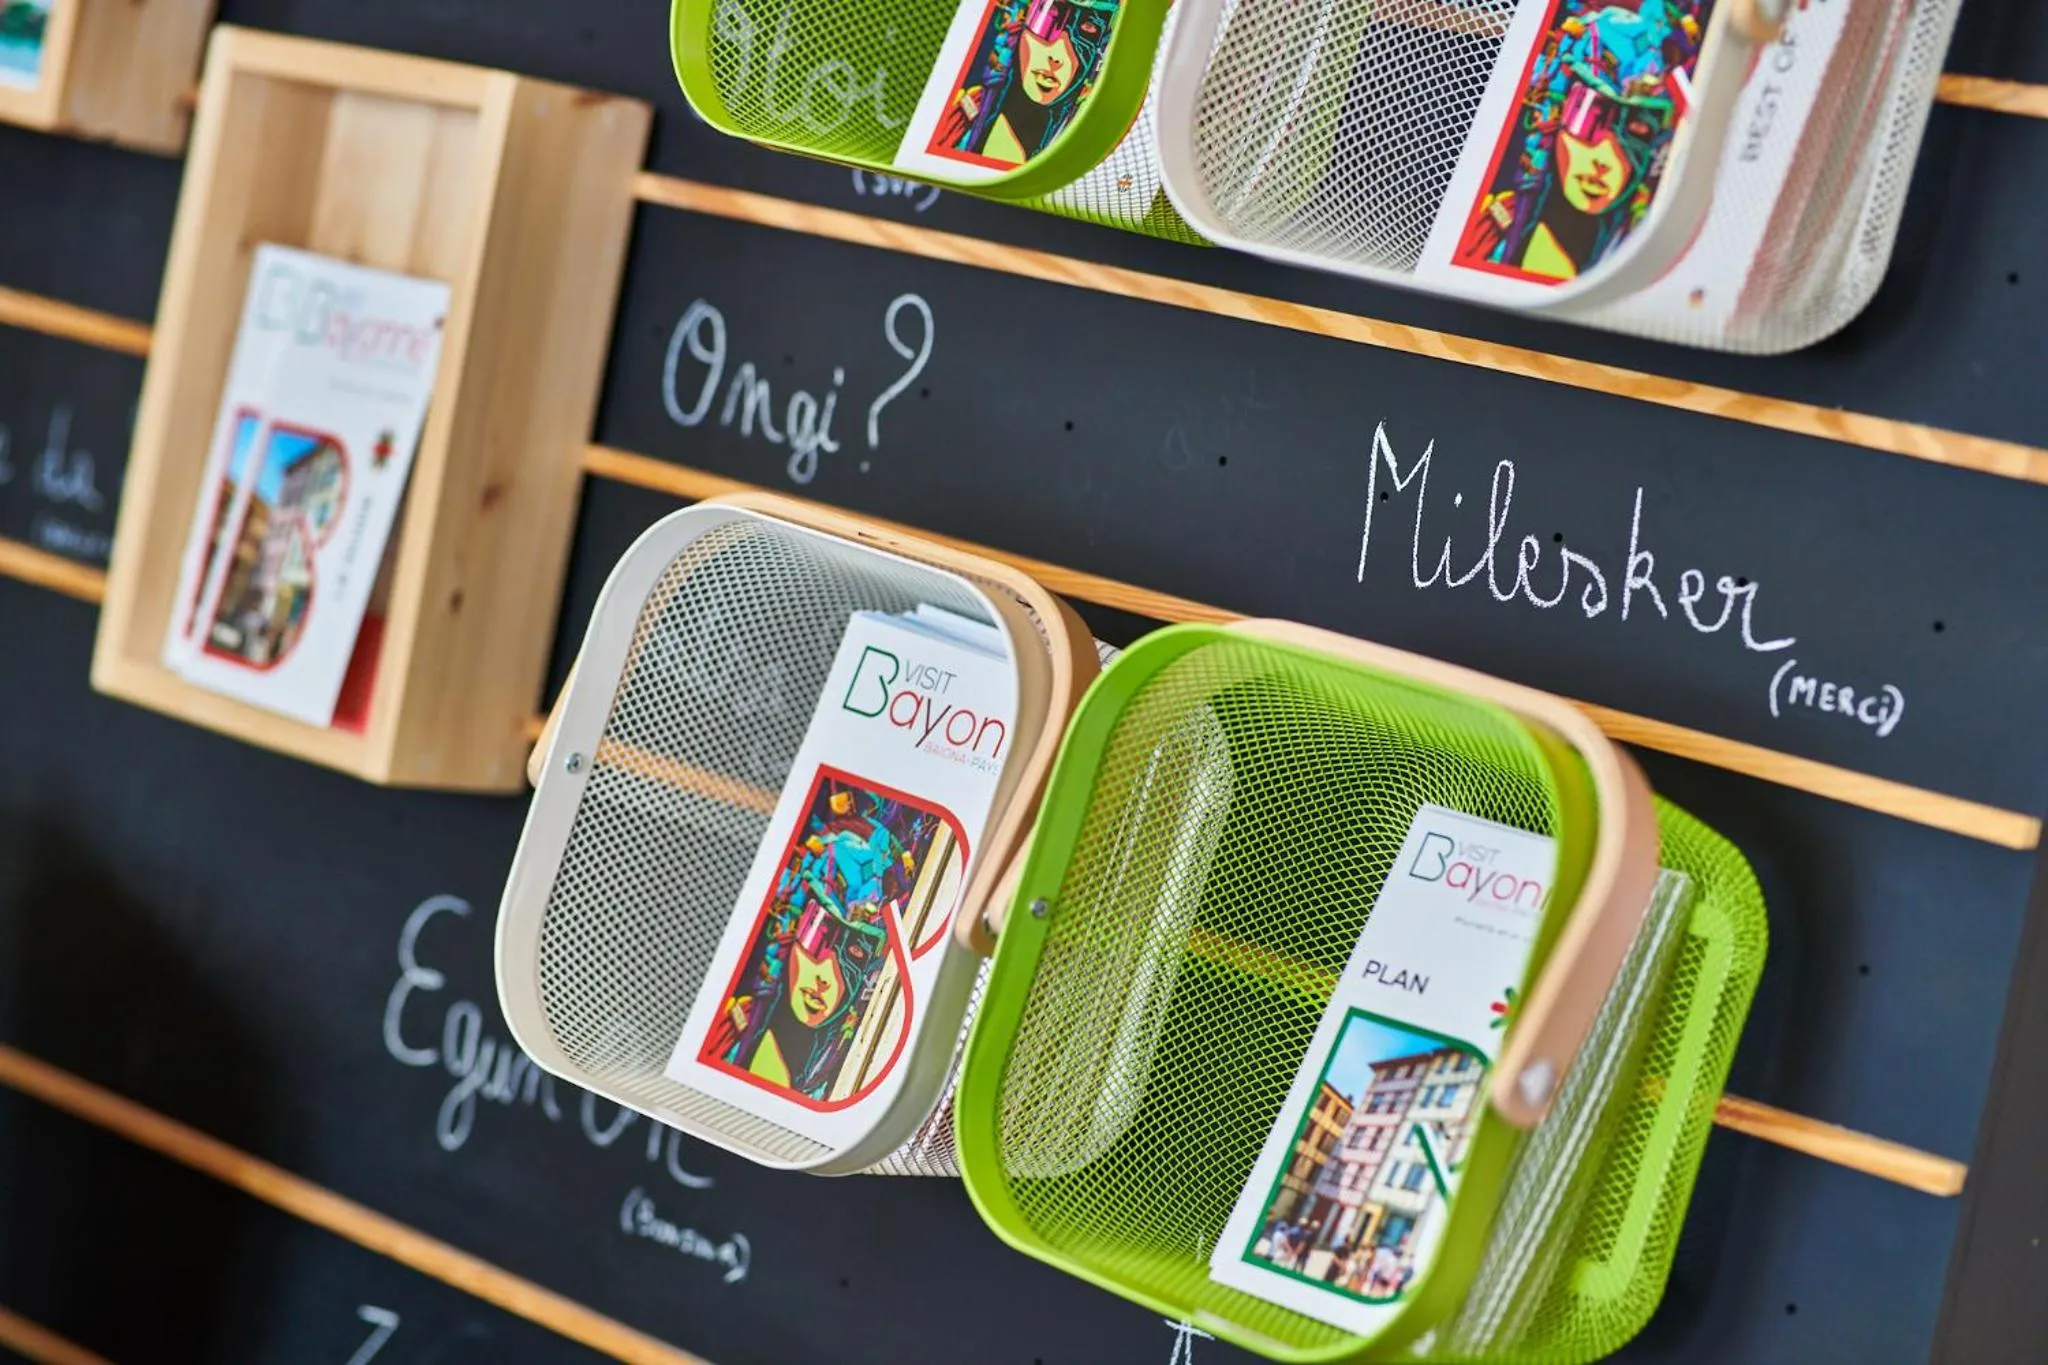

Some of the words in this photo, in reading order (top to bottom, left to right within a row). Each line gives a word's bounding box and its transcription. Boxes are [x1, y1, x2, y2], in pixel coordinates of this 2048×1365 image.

[1357, 416, 1796, 652] Milesker
[903, 659, 958, 695] VISIT
[1457, 839, 1502, 867] VISIT
[1408, 831, 1554, 912] Bayon
[1361, 959, 1430, 995] PLAN
